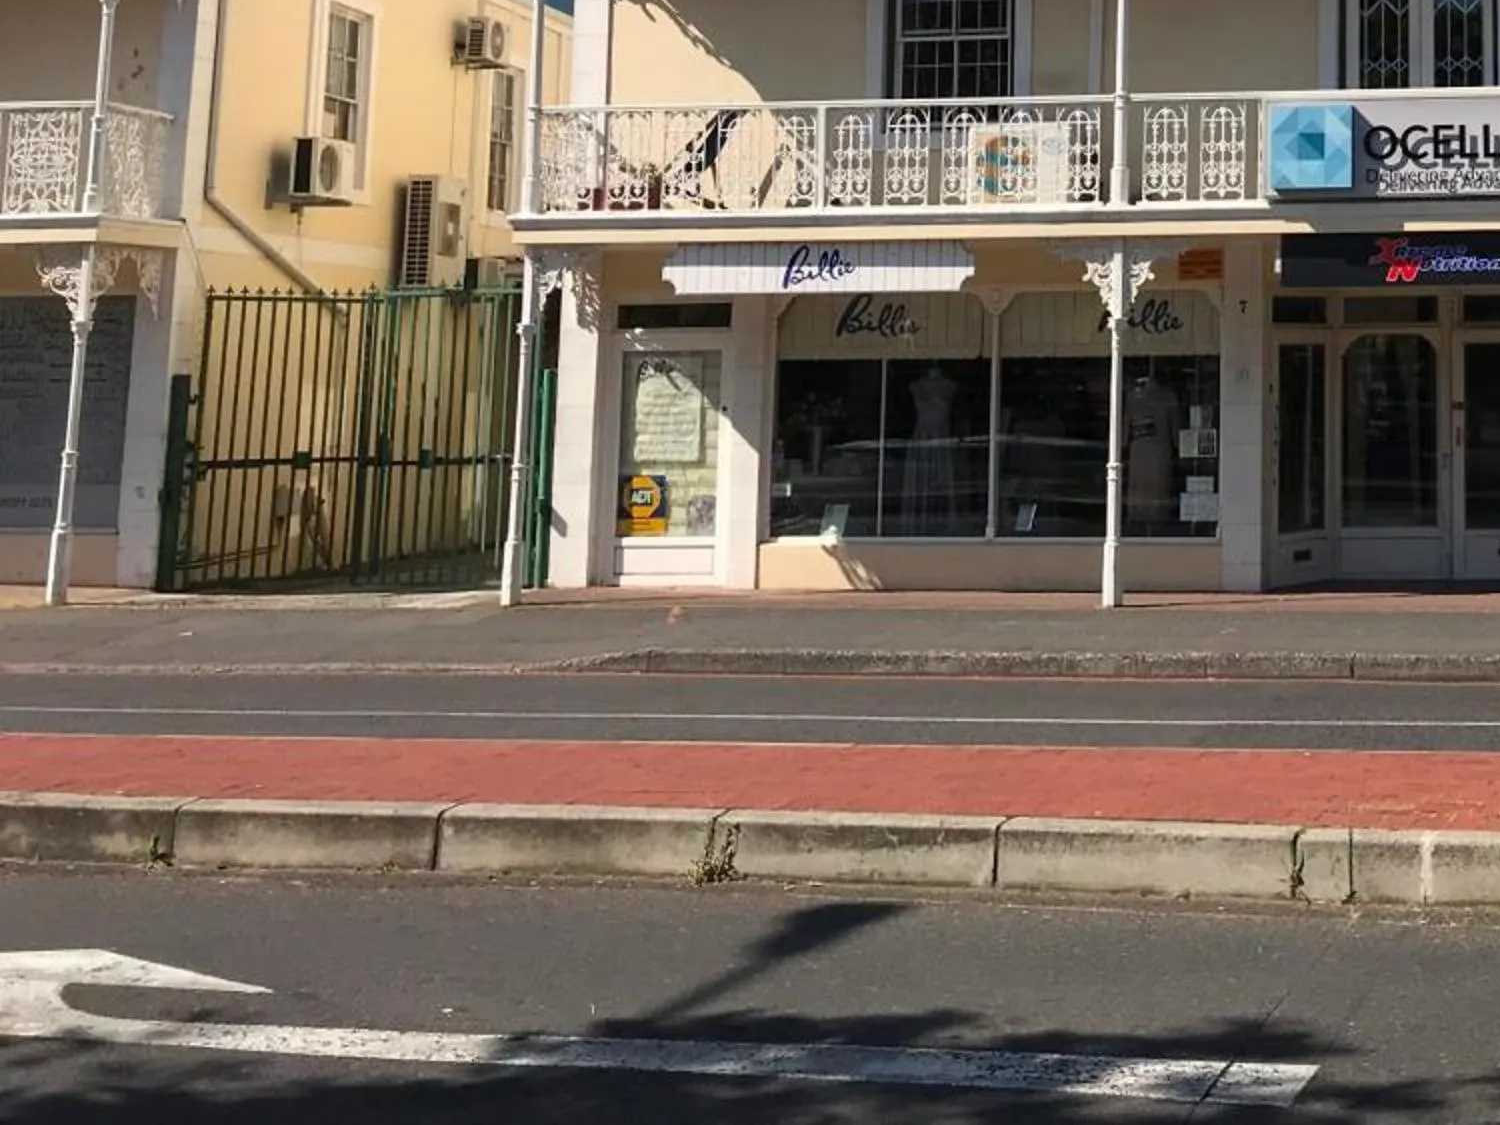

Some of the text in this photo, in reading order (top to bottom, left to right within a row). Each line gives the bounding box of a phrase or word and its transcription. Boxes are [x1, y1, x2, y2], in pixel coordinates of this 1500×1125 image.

[1366, 166, 1449, 189] Delivering
[782, 245, 856, 290] Billie
[836, 293, 921, 337] Billie
